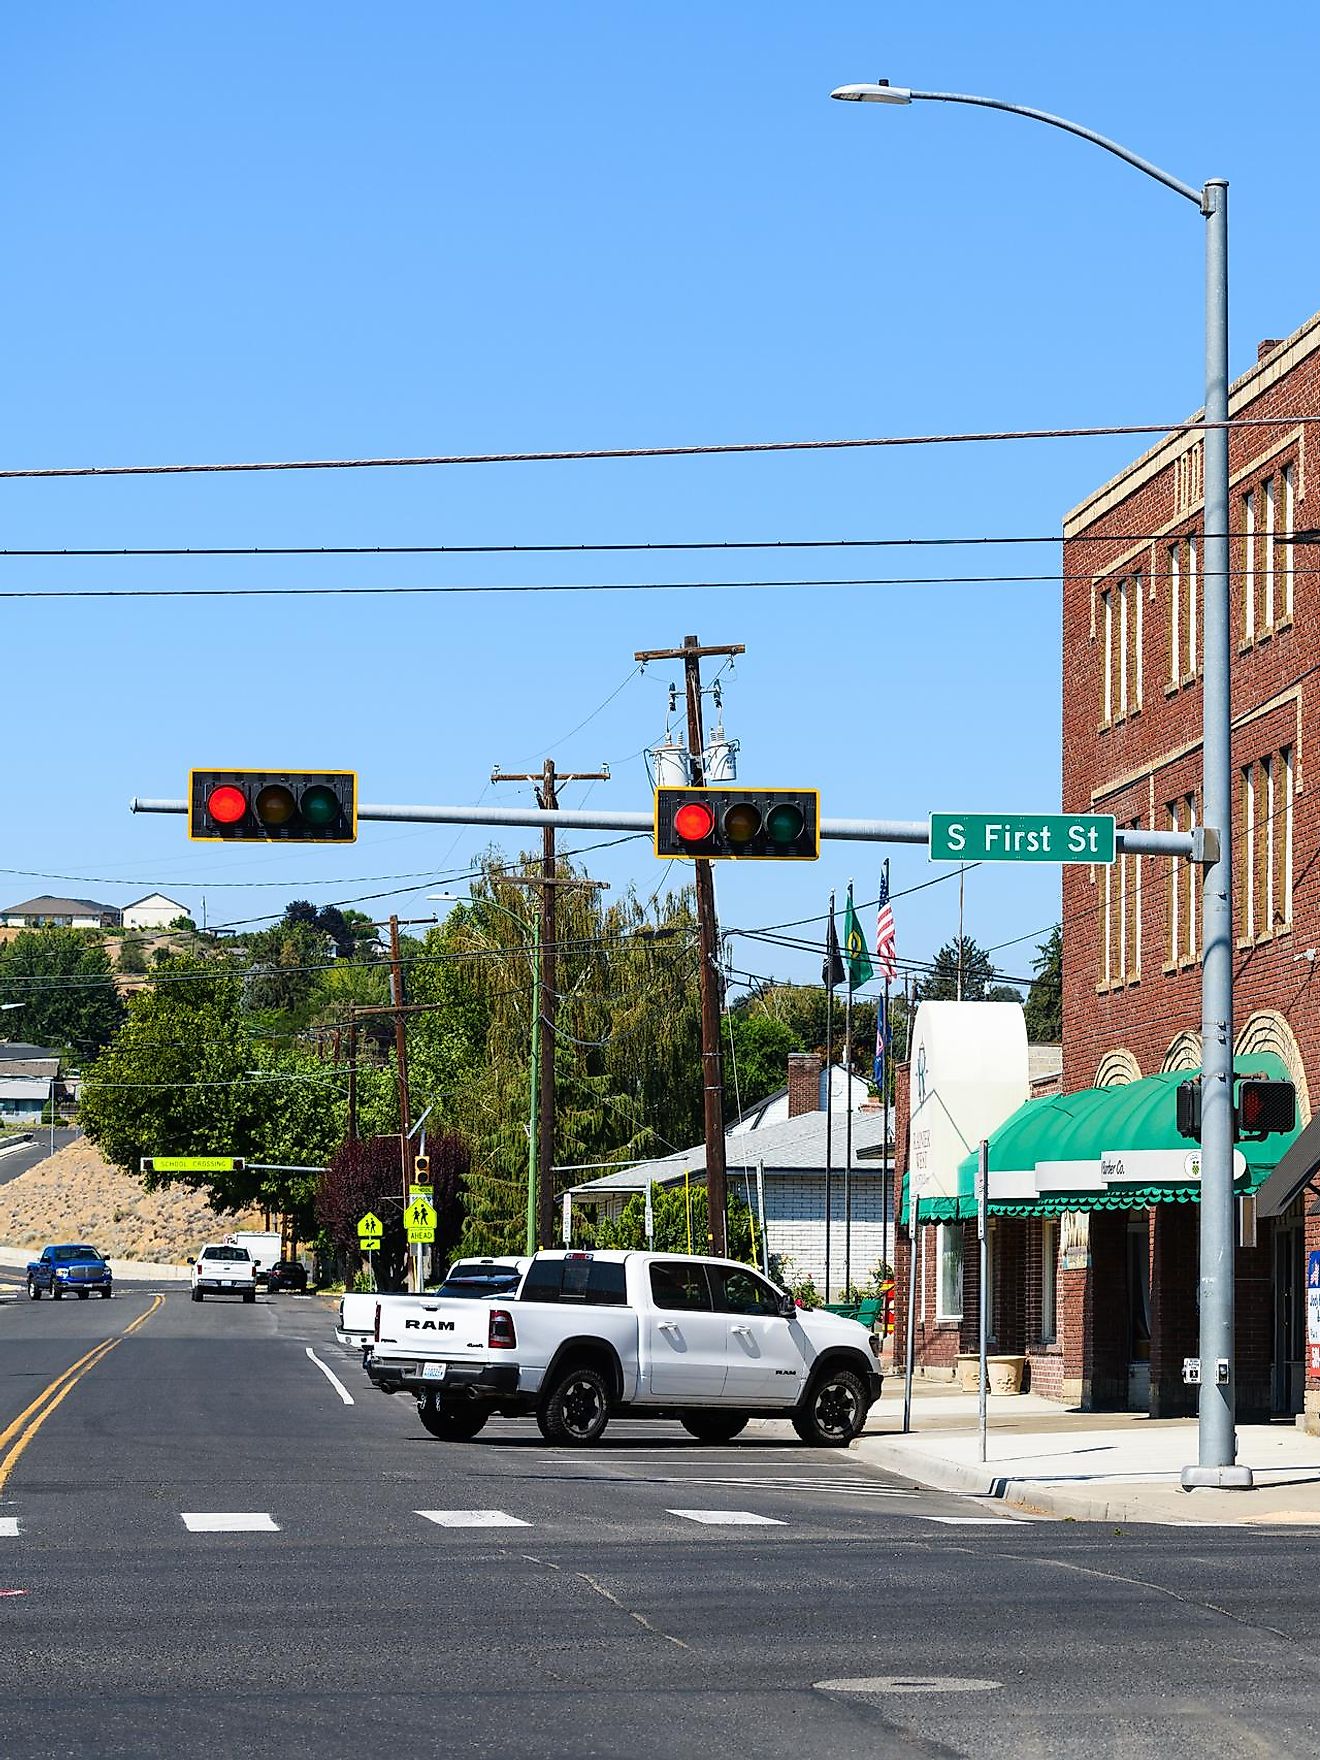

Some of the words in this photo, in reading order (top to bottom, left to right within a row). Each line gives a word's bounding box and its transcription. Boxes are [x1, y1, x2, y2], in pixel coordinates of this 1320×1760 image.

[947, 823, 966, 851] S
[985, 824, 1052, 852] First
[1067, 825, 1099, 853] St
[160, 1160, 187, 1168] SCHOOL
[192, 1160, 226, 1168] CROSSING
[410, 1231, 433, 1240] AHEAD
[405, 1319, 455, 1331] RAM
